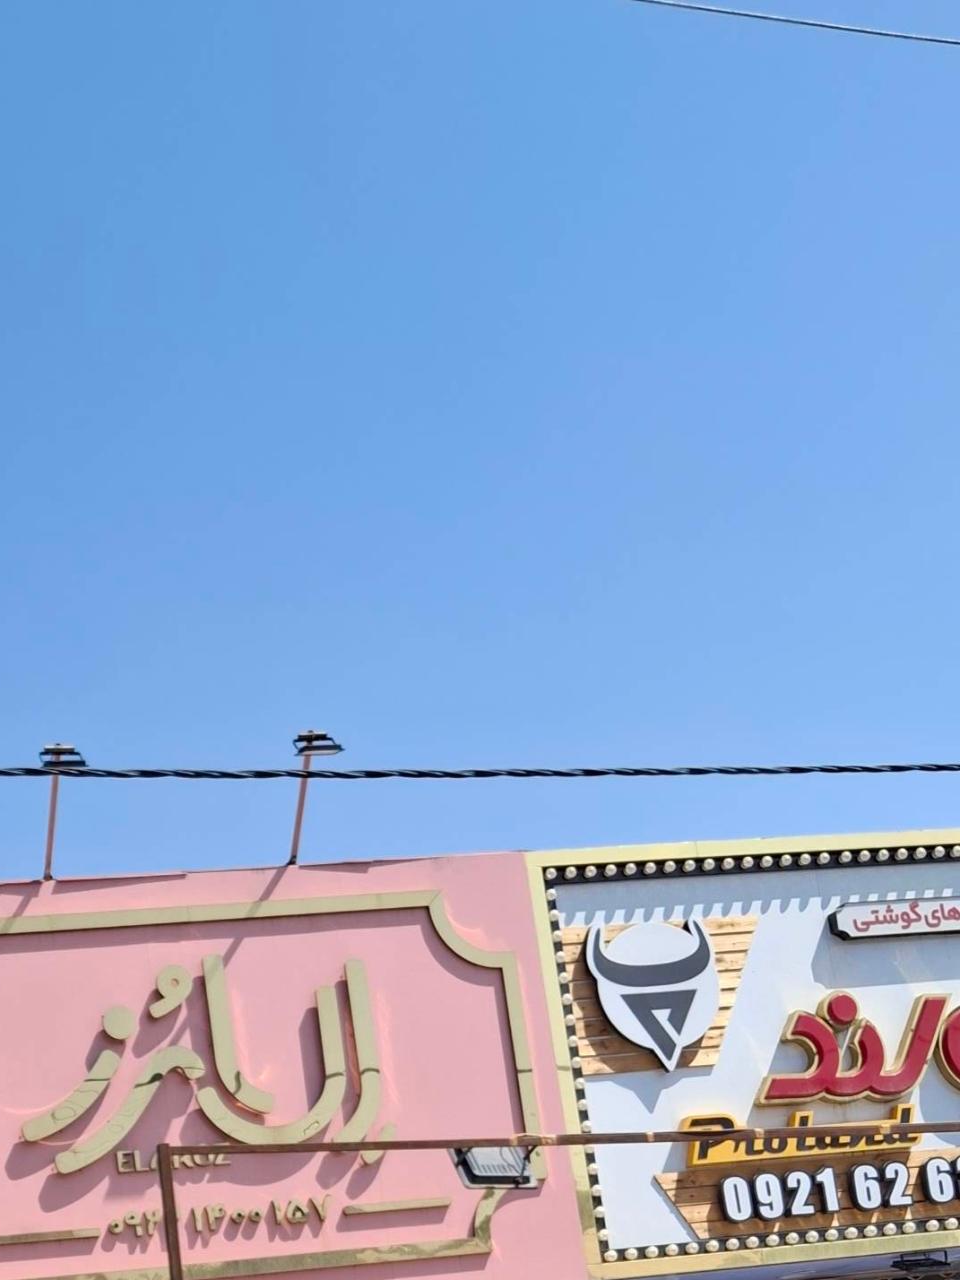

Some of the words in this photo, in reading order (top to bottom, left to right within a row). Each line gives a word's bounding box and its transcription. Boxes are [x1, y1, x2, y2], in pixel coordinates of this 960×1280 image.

[853, 900, 922, 933] گوشتی
[721, 1167, 840, 1222] 0921
[852, 1160, 913, 1212] 62
[925, 1156, 960, 1205] 6
